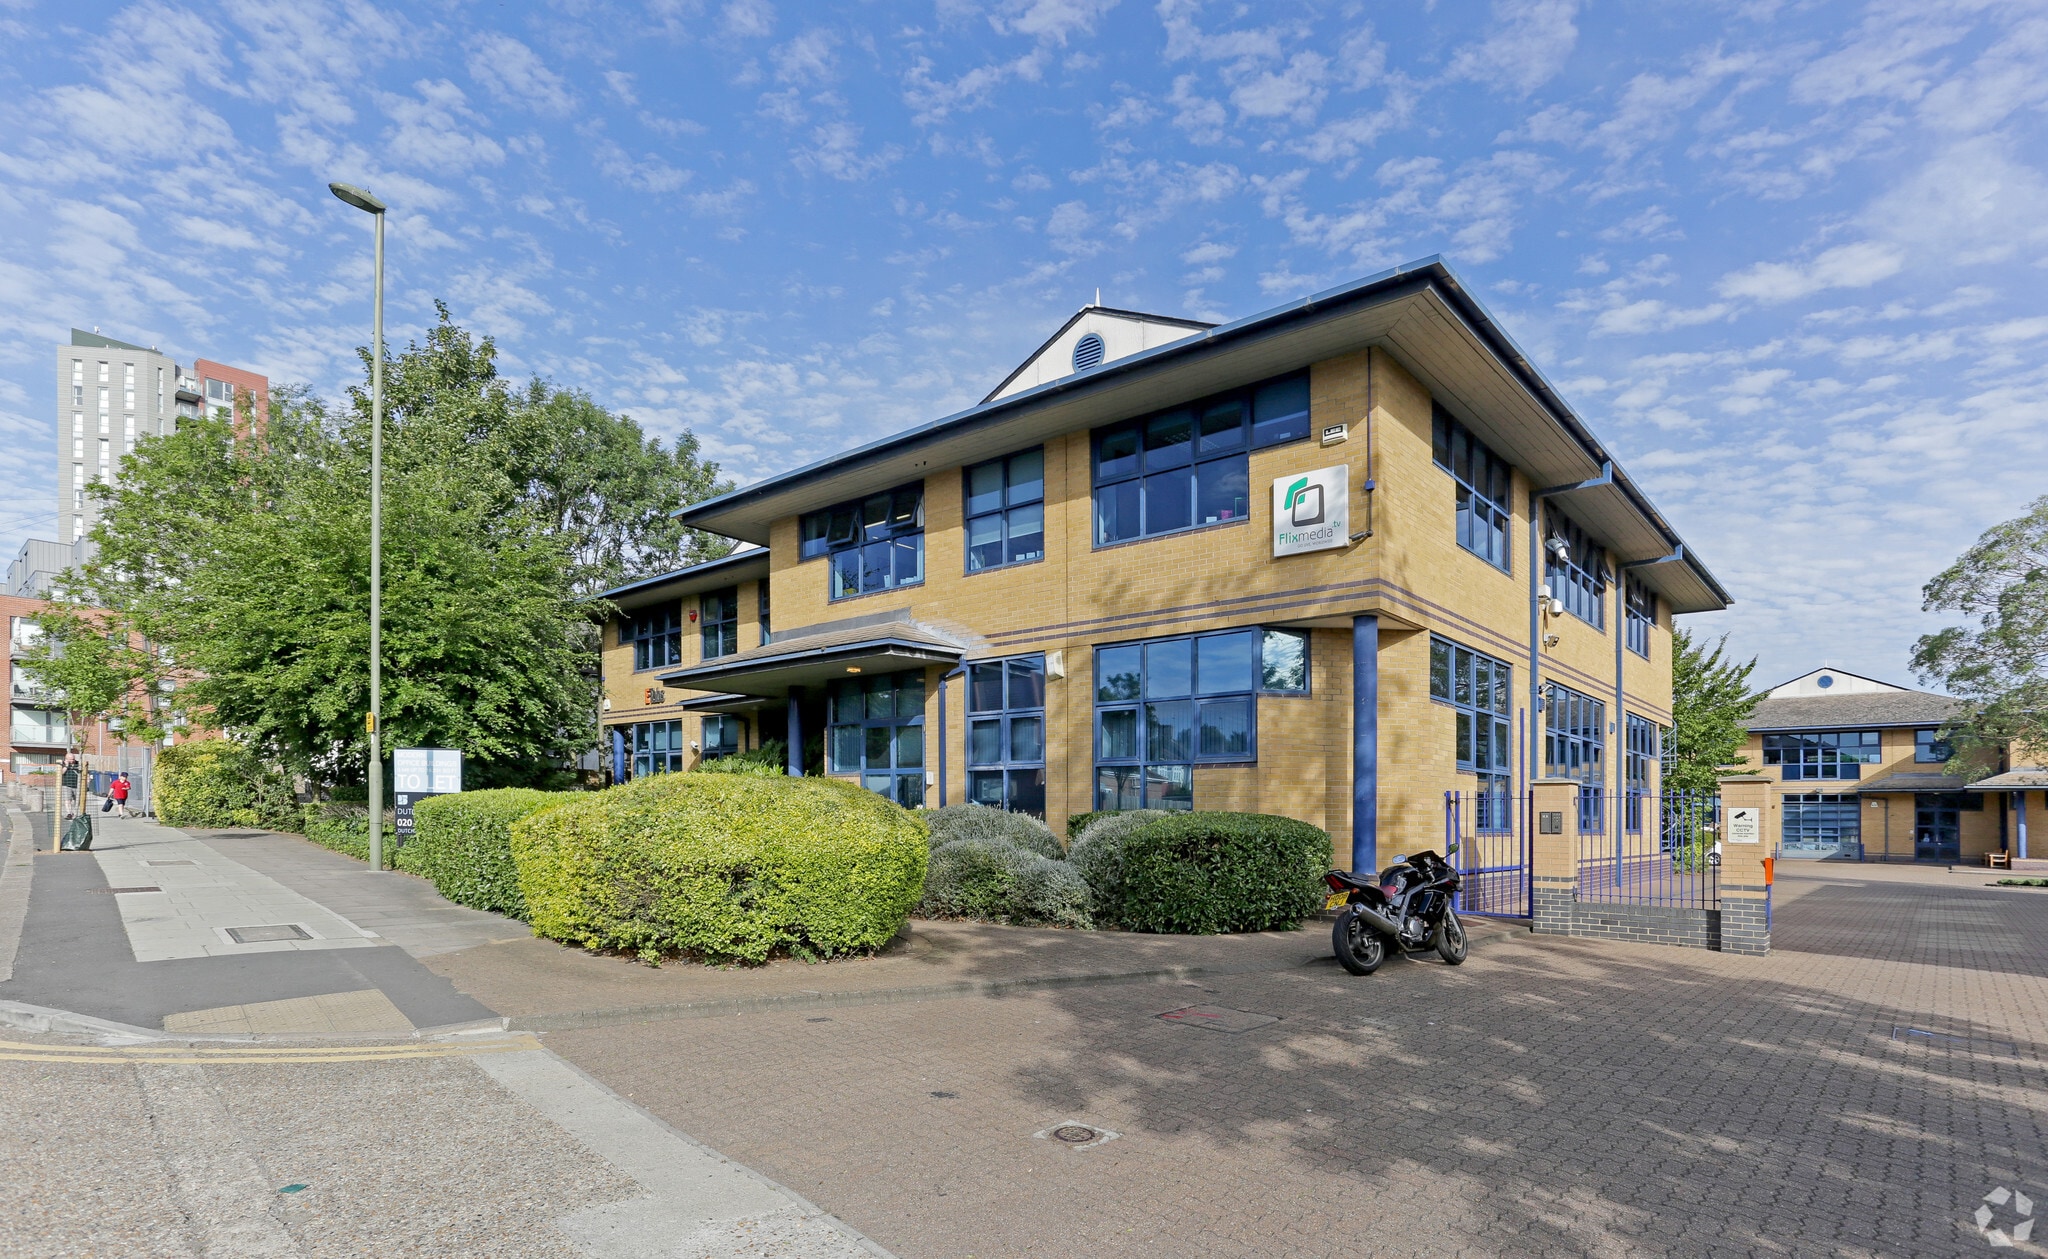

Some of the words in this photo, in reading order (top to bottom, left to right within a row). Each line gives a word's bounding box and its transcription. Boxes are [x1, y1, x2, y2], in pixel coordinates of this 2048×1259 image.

[1279, 527, 1333, 545] Flixmedia
[397, 774, 420, 789] TO
[427, 775, 456, 790] LET
[397, 818, 413, 827] 020
